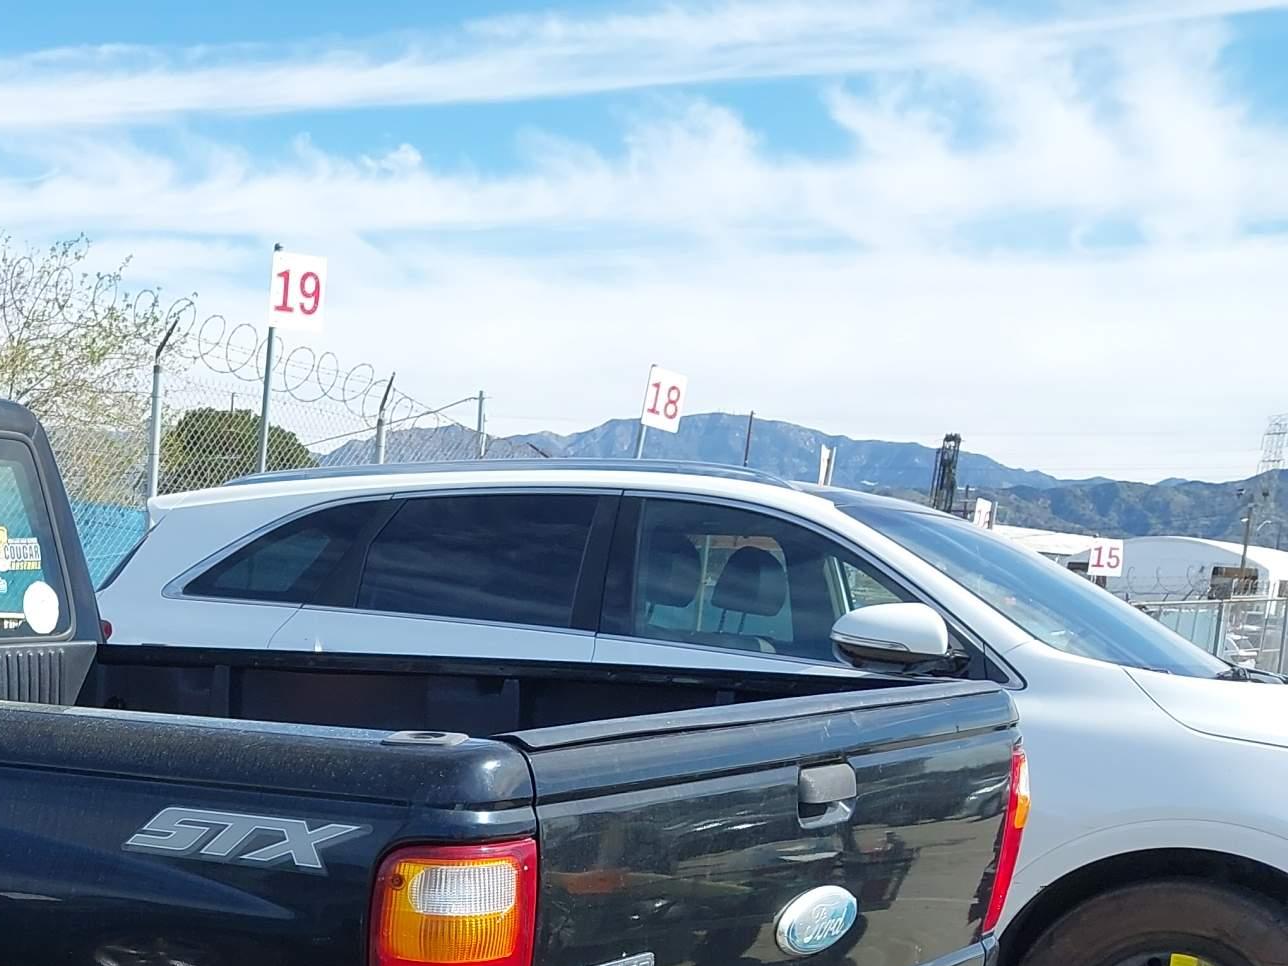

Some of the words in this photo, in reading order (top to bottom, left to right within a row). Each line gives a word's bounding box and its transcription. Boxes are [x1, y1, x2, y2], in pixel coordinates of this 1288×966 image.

[274, 269, 321, 315] 19
[647, 382, 681, 420] 18
[3, 544, 40, 560] COUGAR
[1091, 547, 1120, 569] 15
[126, 807, 362, 869] STX
[803, 903, 848, 943] Ford
